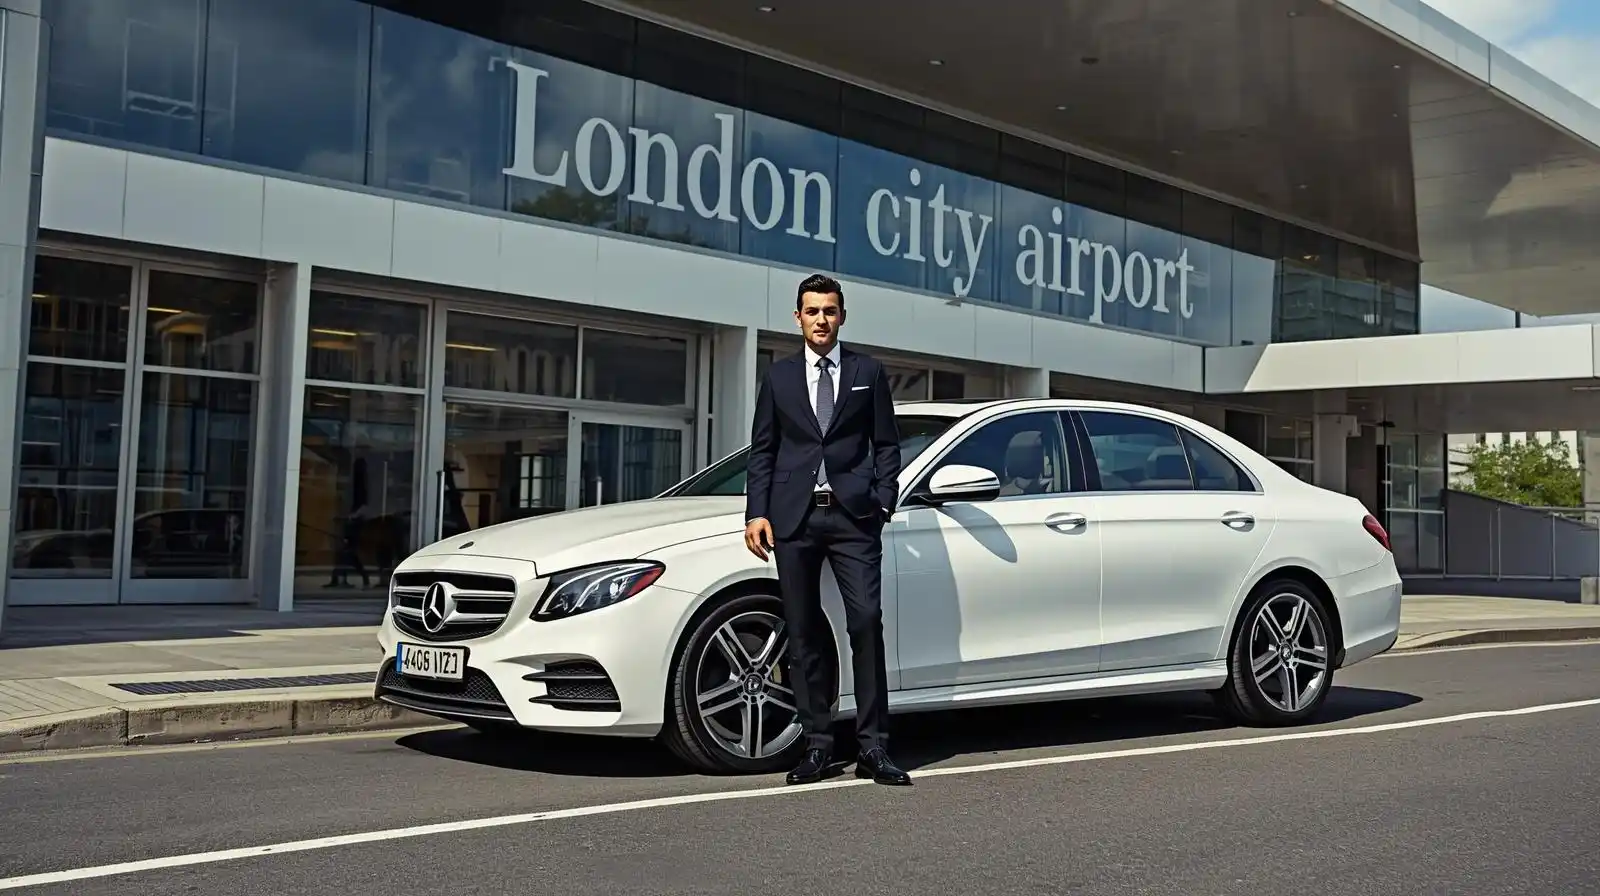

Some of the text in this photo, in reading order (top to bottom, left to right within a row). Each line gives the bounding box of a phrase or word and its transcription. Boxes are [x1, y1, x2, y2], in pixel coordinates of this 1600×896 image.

[502, 60, 1194, 325] London city airport
